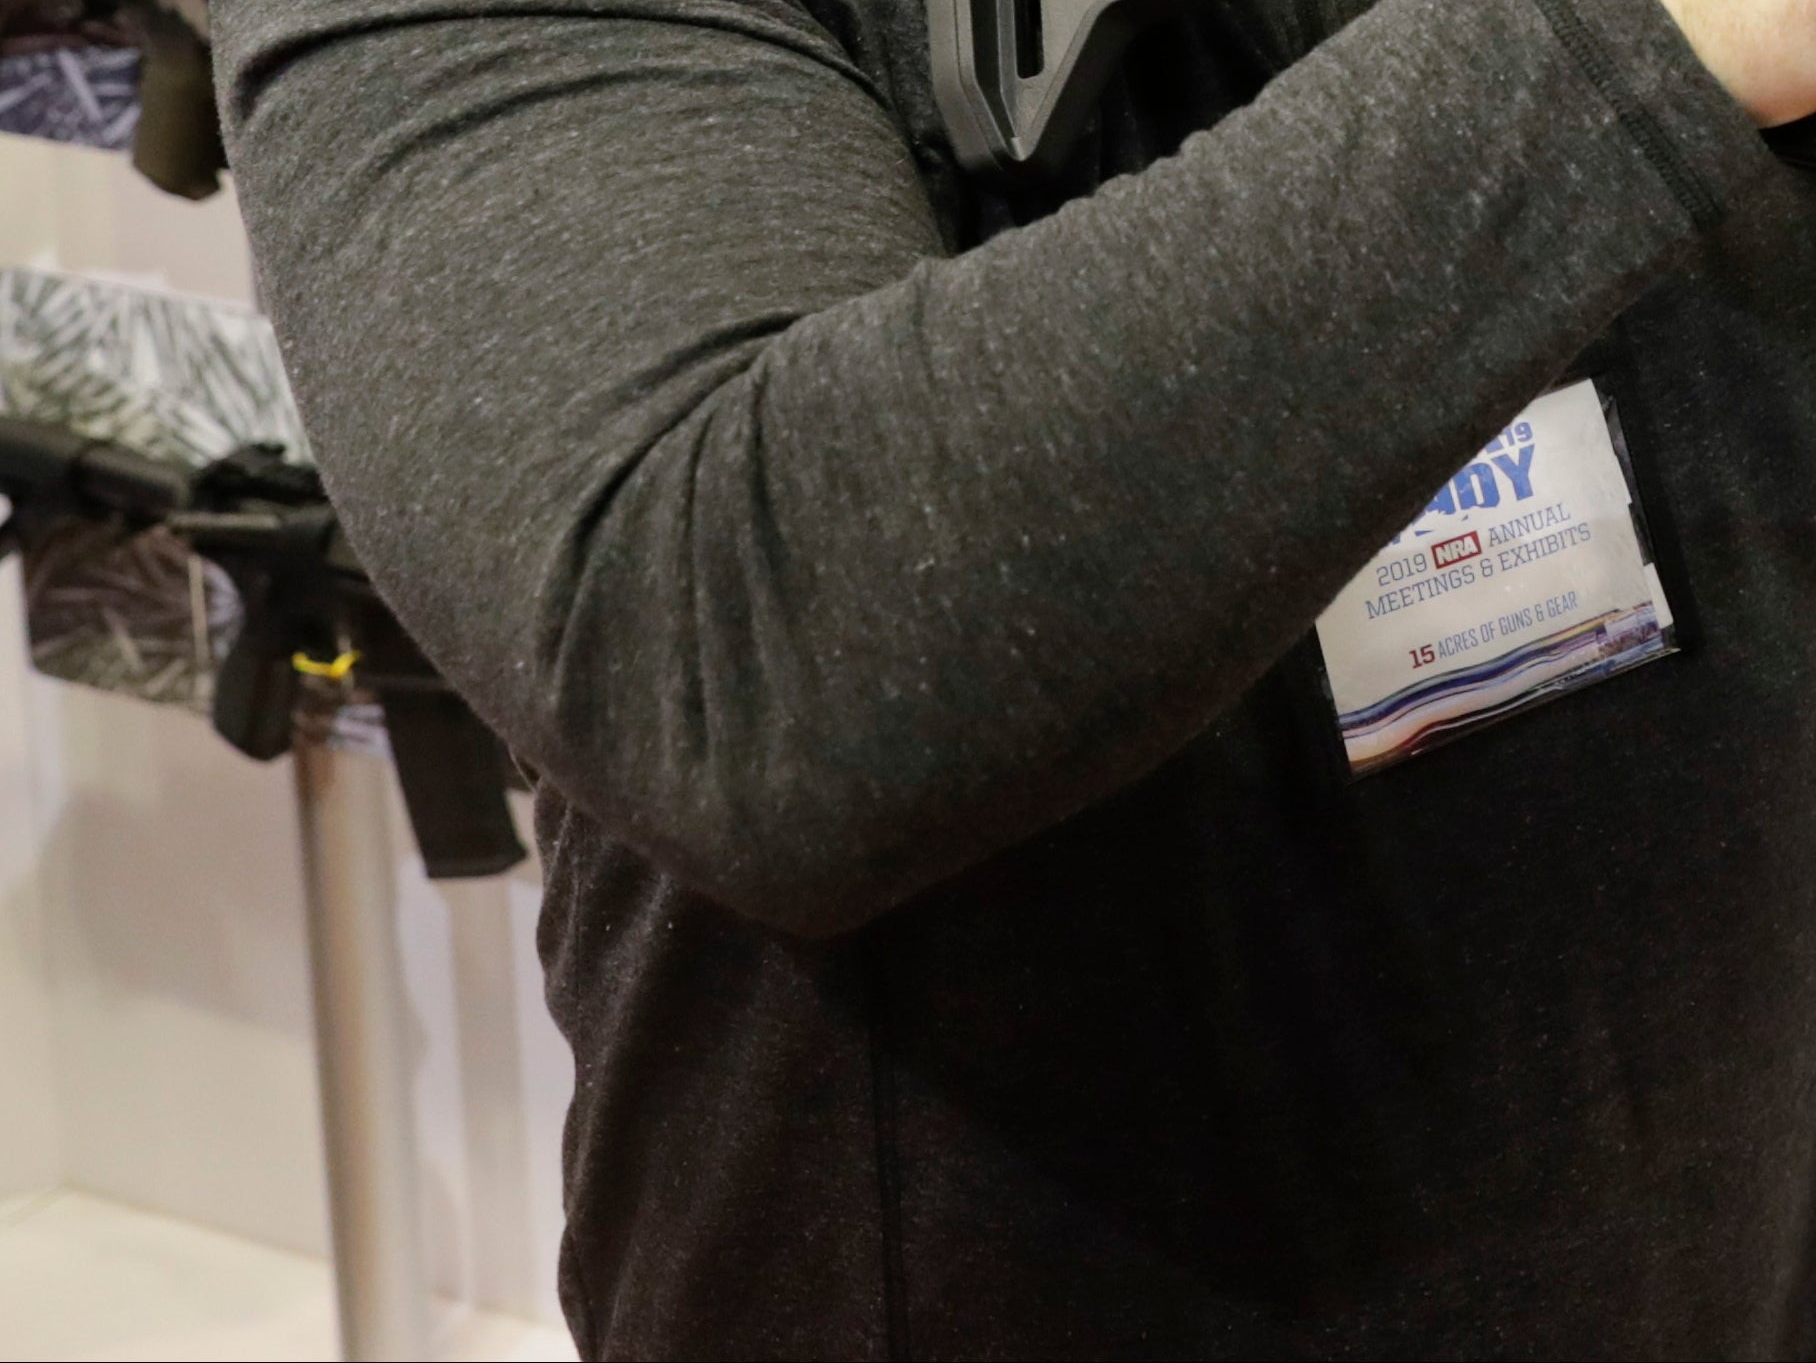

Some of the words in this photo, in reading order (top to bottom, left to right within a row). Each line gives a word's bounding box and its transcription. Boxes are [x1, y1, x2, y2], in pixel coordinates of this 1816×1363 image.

[1365, 564, 1476, 620] MEETINGS
[1480, 557, 1494, 578] &
[1497, 522, 1591, 572] EXHIBITS
[1376, 552, 1428, 587] 2019
[1435, 535, 1479, 565] NRA
[1488, 503, 1572, 548] ANNUAL
[1409, 643, 1437, 669] 15
[1438, 627, 1478, 659] ACRES
[1480, 620, 1496, 644] OF
[1500, 607, 1533, 636] GUNS
[1535, 603, 1545, 623] &
[1547, 590, 1579, 618] GEAR
